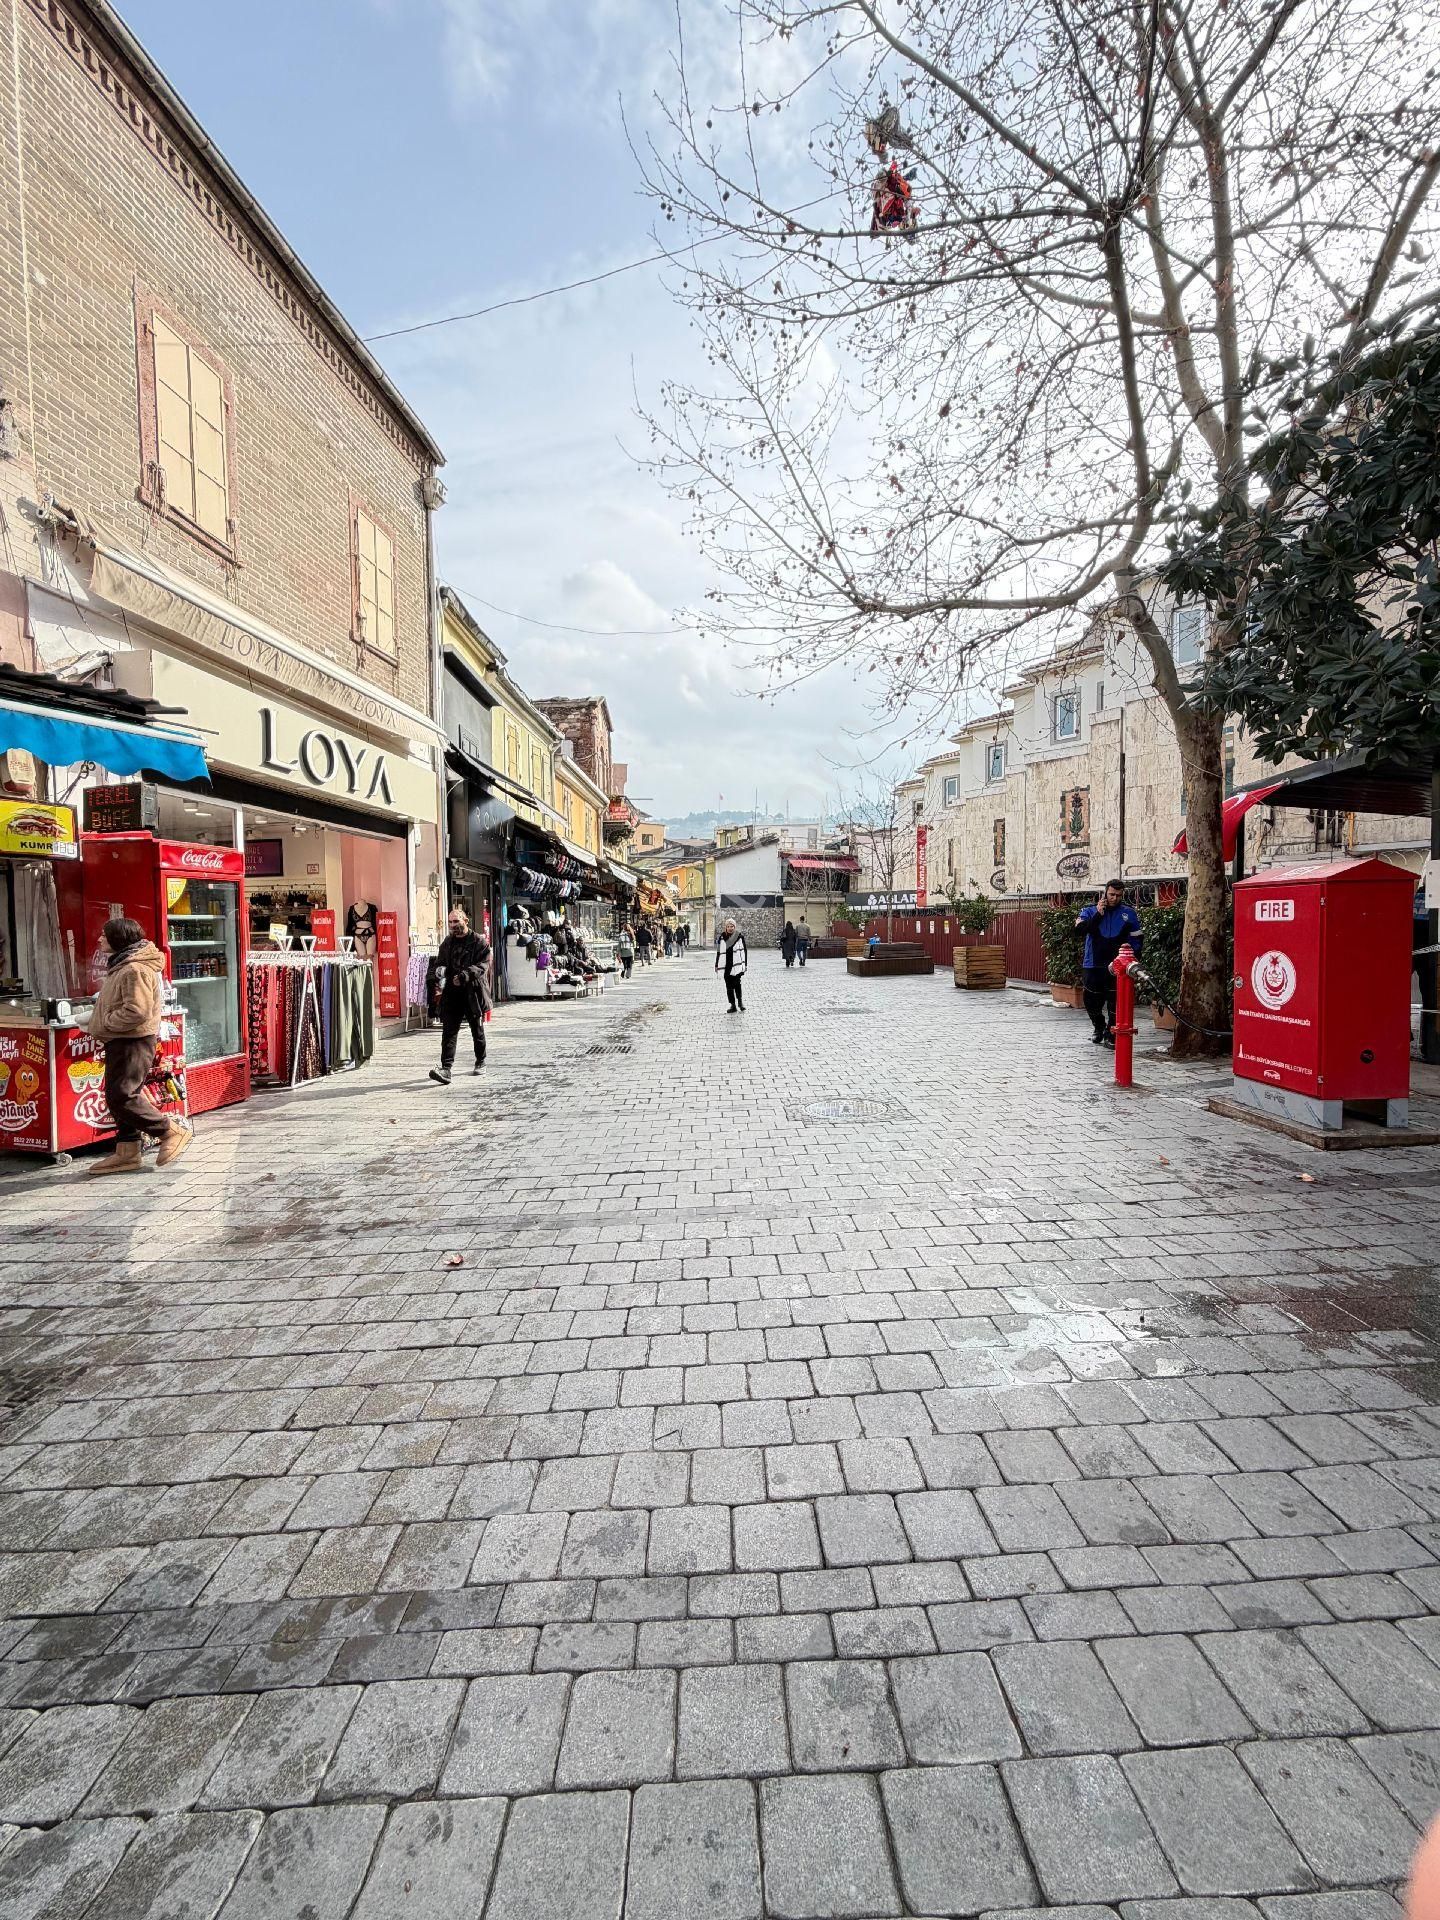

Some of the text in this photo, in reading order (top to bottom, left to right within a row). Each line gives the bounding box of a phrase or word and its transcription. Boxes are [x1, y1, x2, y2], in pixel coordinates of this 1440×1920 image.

[219, 625, 280, 672] LOYA
[353, 695, 399, 727] LOYA
[258, 707, 396, 805] LOYA
[86, 785, 135, 806] TEKEL
[91, 808, 131, 829] BÜFE
[20, 841, 53, 850] KUMR
[1260, 902, 1289, 918] FIRE
[26, 1041, 45, 1057] TANE
[27, 1032, 46, 1048] TANE
[21, 1049, 48, 1066] LEZZET
